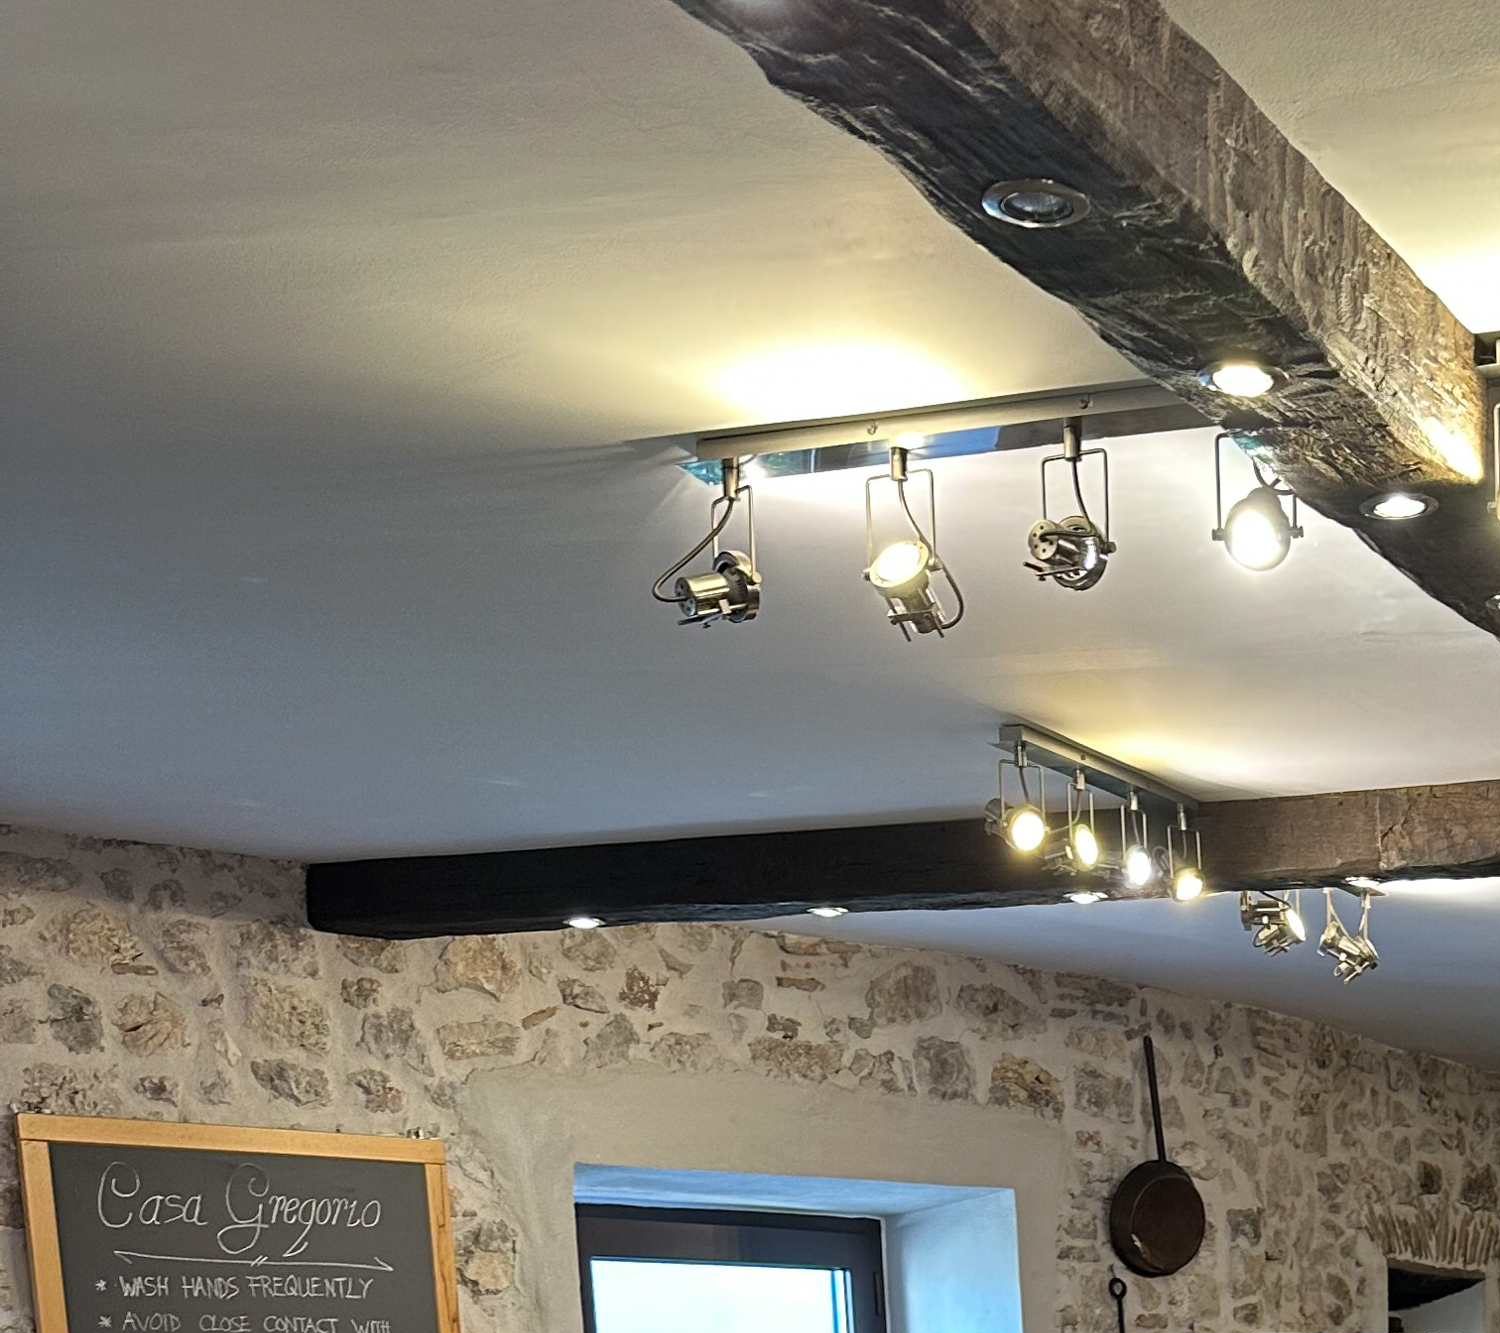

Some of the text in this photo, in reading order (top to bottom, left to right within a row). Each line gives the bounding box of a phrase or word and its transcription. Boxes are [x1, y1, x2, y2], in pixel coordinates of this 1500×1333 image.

[97, 1160, 382, 1258] Casa Gregorio
[118, 1274, 375, 1301] WASH HANDS FREQUENTLY
[121, 1311, 182, 1333] AVOID
[198, 1314, 252, 1333] CLOSE
